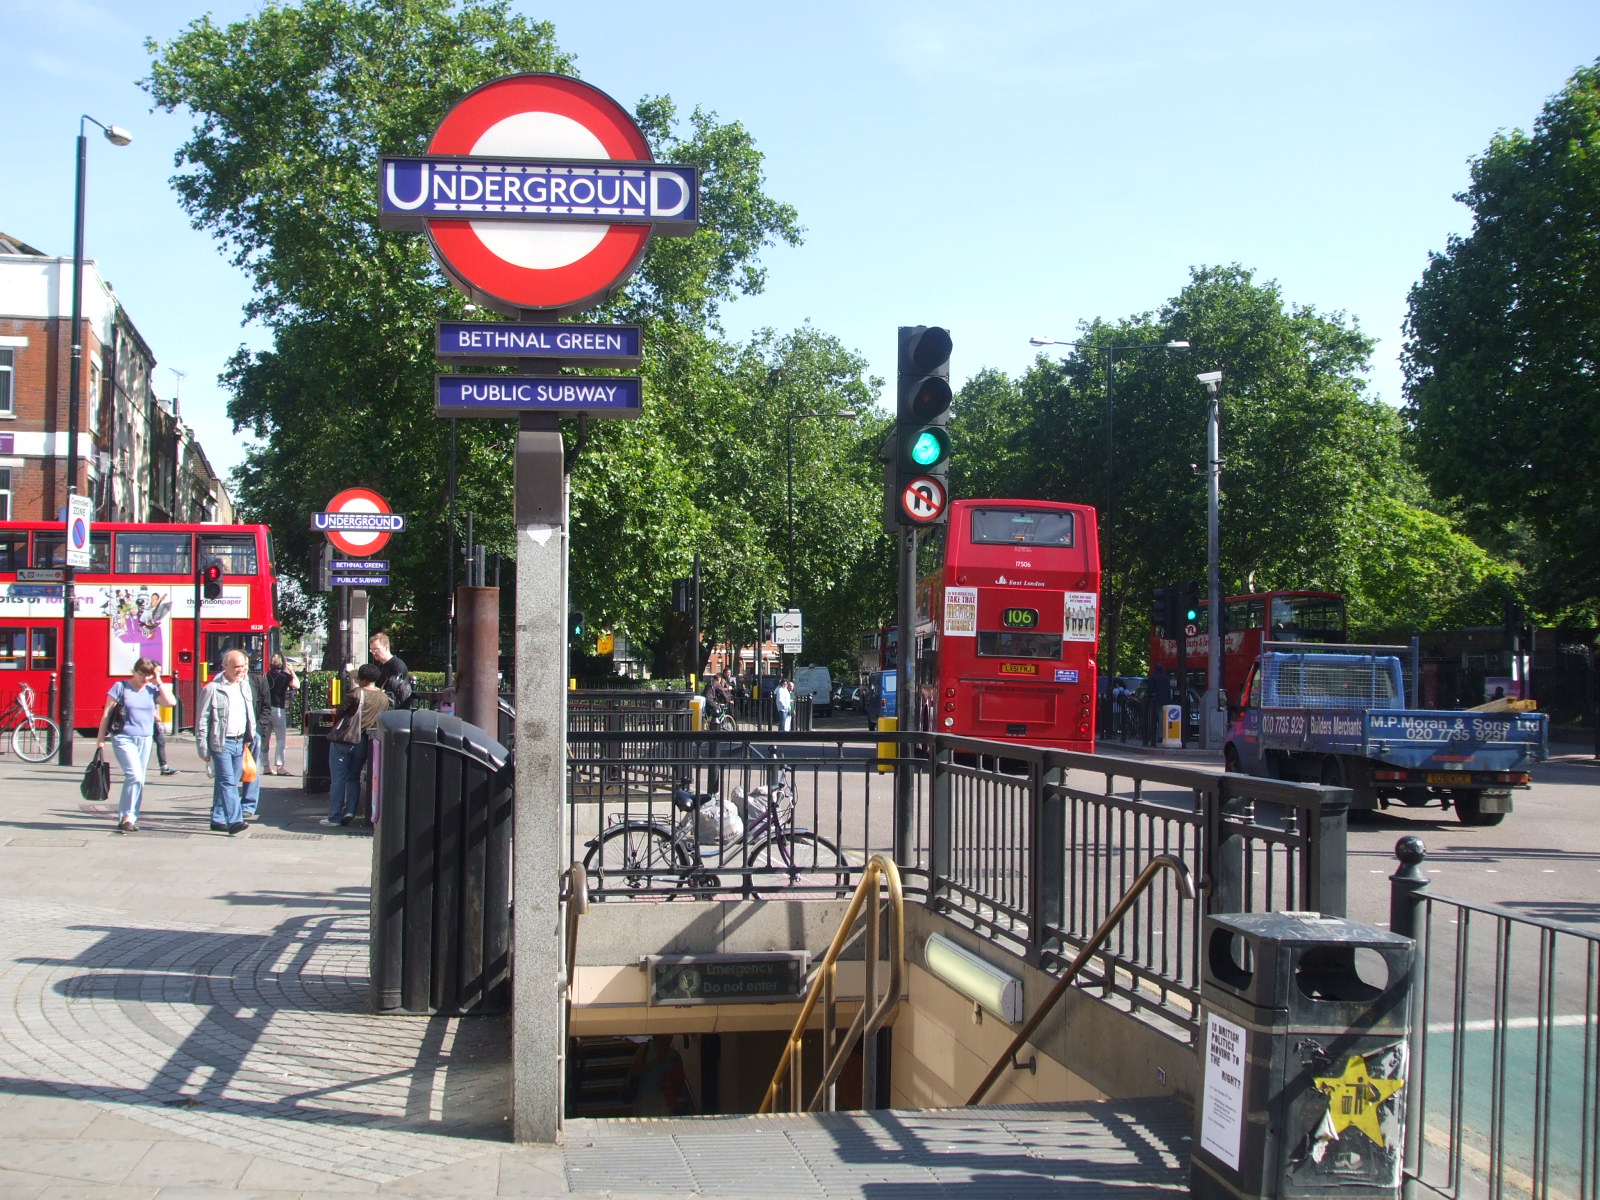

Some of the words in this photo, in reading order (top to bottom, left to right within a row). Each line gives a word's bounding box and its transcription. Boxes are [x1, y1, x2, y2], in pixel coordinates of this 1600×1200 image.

[386, 162, 690, 217] UNDERGROUND
[459, 331, 550, 350] BETHNAL
[556, 333, 621, 350] GREEN
[461, 384, 531, 401] PUBLIC
[537, 385, 617, 402] SUBWAY
[73, 506, 86, 516] ZONE
[315, 513, 404, 530] UNDERGROUND
[186, 597, 242, 606] thondonpaper
[947, 595, 960, 603] TAKE
[962, 596, 976, 604] THAT
[1008, 609, 1032, 624] 106
[1262, 715, 1274, 733] 020
[1275, 716, 1289, 734] 7735
[1310, 716, 1332, 736] Builders
[1333, 716, 1362, 737] Merchants
[1370, 716, 1447, 730] M.P.Moran
[1454, 718, 1465, 730] &
[1472, 718, 1511, 731] Sons
[1517, 720, 1540, 732] Ltd
[1406, 728, 1433, 740] 020
[1438, 729, 1470, 741] 7735
[1475, 730, 1507, 742] 9291
[705, 963, 775, 977] Emergency
[703, 981, 719, 993] Do
[723, 981, 742, 993] not
[746, 980, 778, 992] enter
[1211, 1022, 1218, 1033] IS
[1218, 1023, 1240, 1044] BRITISH
[1211, 1032, 1235, 1052] POLITICS
[1210, 1043, 1231, 1060] MOVING
[1232, 1054, 1240, 1066] TO
[1210, 1053, 1221, 1067] THE
[1221, 1070, 1241, 1090] RIGHT?
